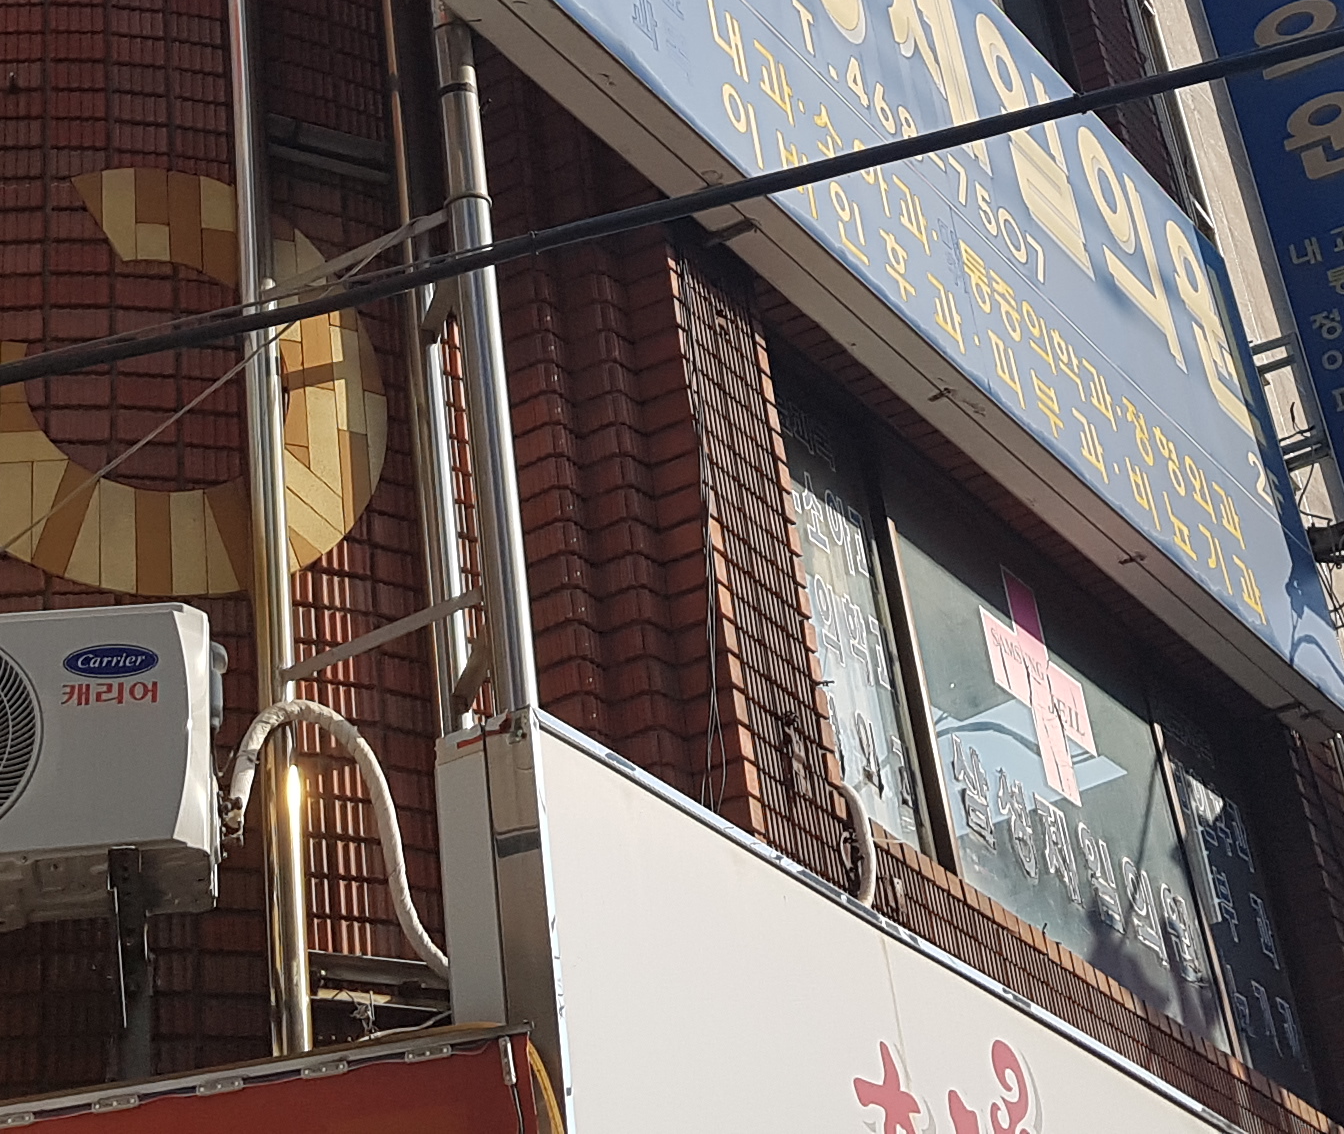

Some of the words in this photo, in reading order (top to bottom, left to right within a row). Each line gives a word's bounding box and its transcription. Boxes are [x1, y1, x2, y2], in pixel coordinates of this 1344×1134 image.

[76, 651, 147, 670] Carrier
[60, 681, 159, 707] 캐리어
[951, 732, 1209, 988] 삼성제일의원
